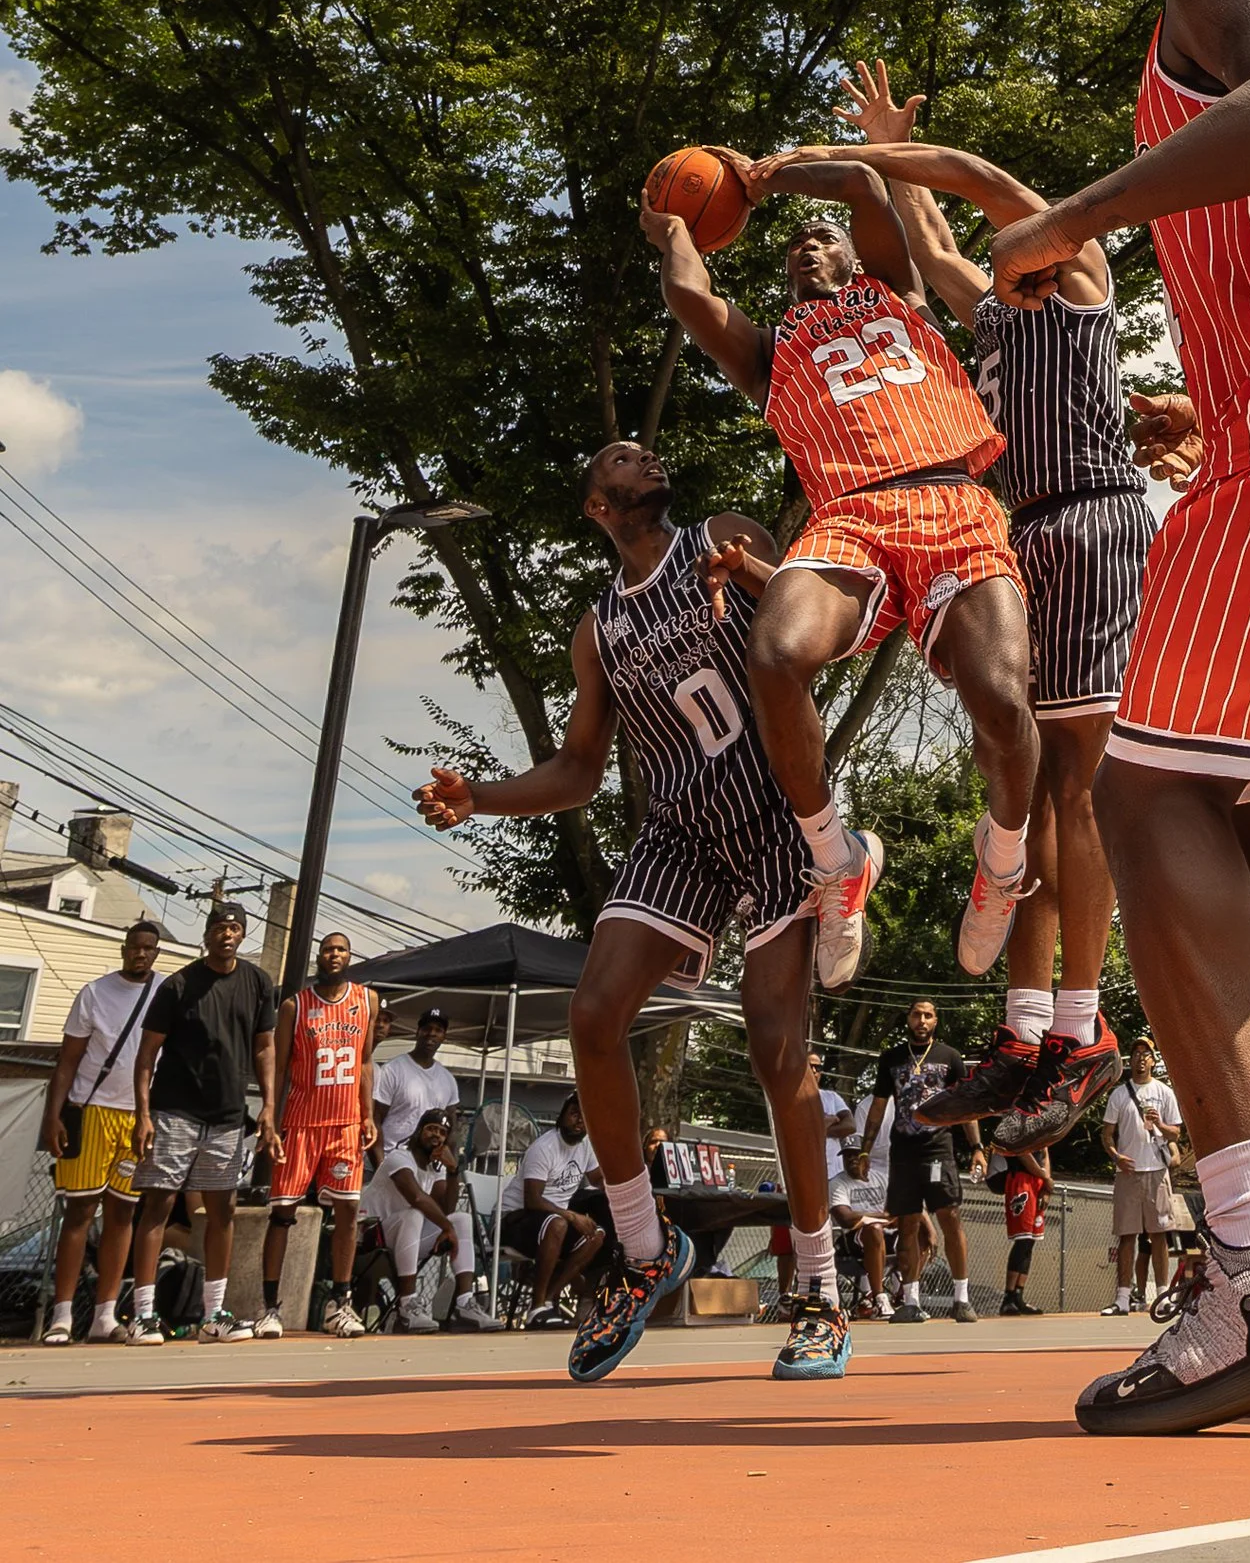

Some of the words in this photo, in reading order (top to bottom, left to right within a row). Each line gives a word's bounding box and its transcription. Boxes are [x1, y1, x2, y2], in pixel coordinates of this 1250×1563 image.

[811, 317, 927, 407] 23
[673, 667, 743, 757] 0
[315, 1046, 356, 1086] 22
